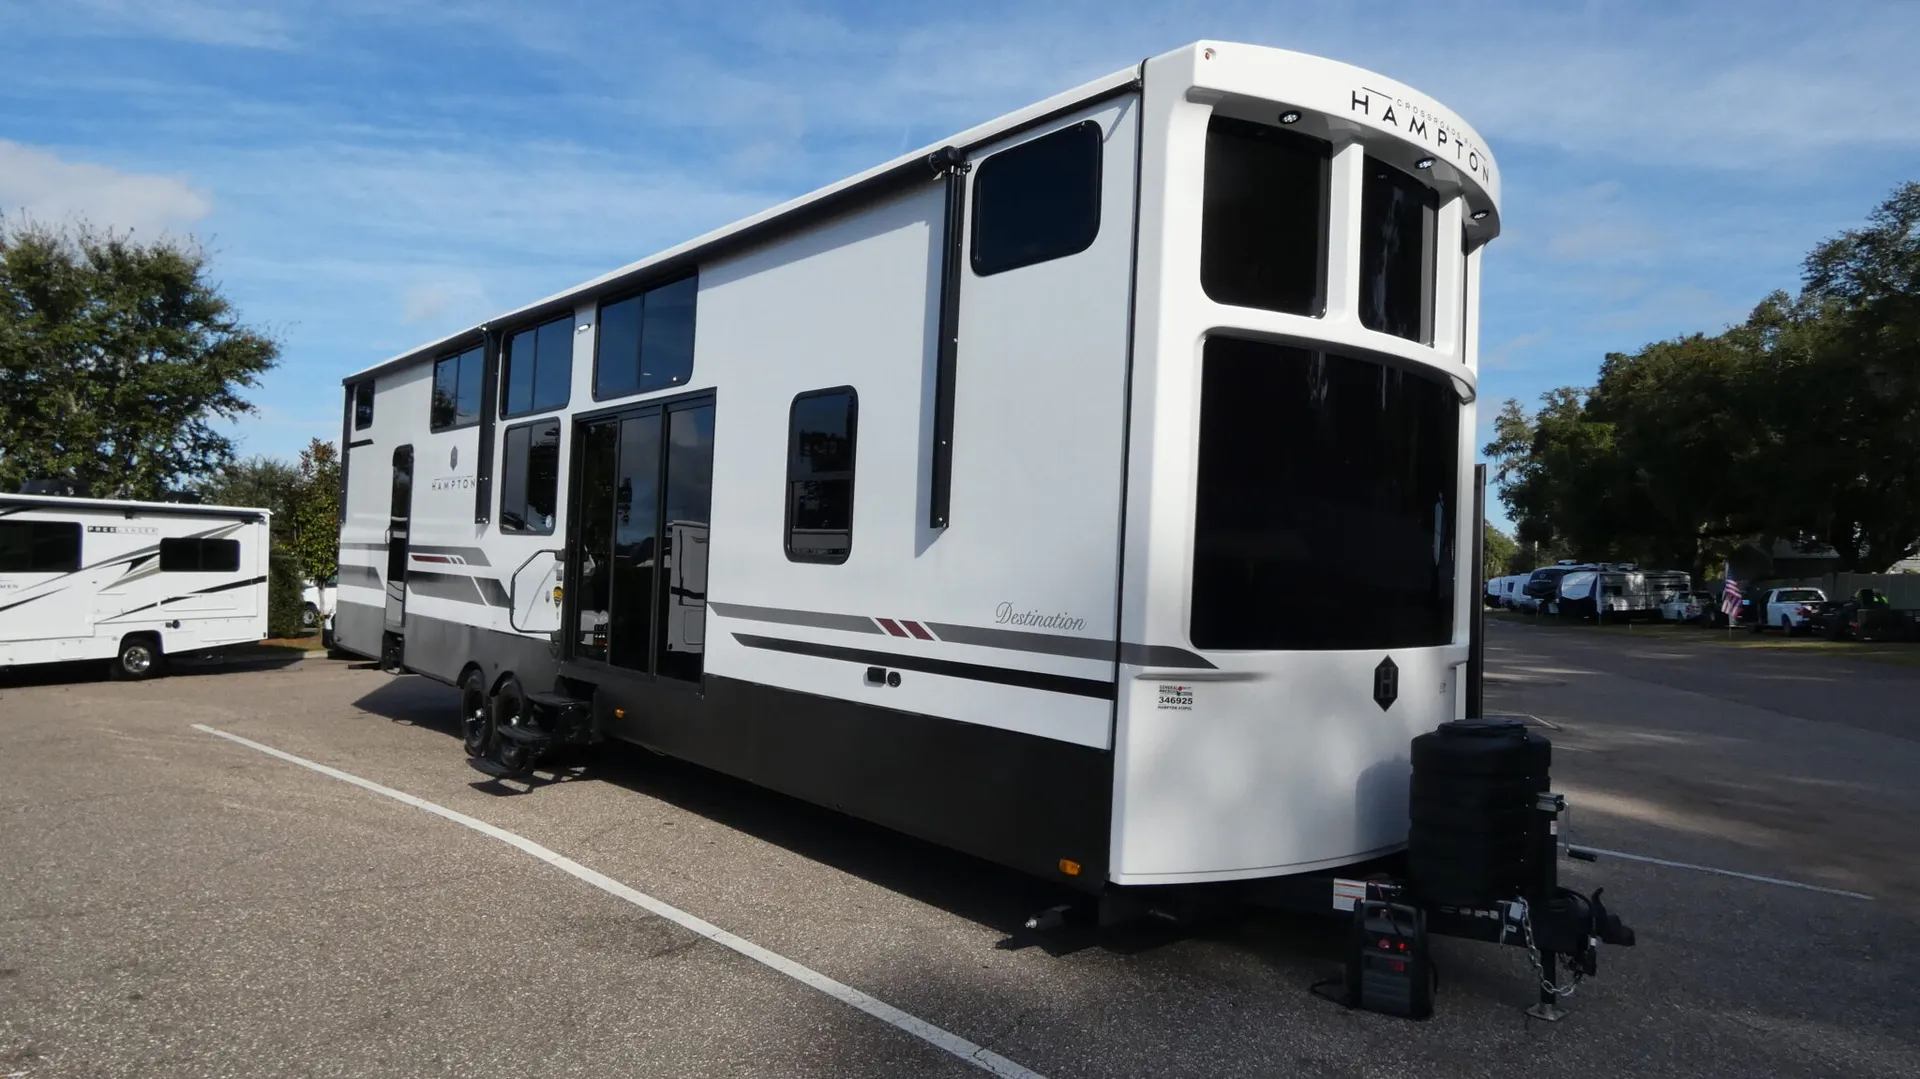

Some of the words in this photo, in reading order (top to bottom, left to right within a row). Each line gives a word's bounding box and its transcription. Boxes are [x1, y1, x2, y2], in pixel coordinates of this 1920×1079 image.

[1352, 90, 1490, 184] HAMPTON
[431, 478, 475, 491] HAMPTON
[995, 601, 1088, 631] Destination
[1158, 696, 1193, 705] 346925
